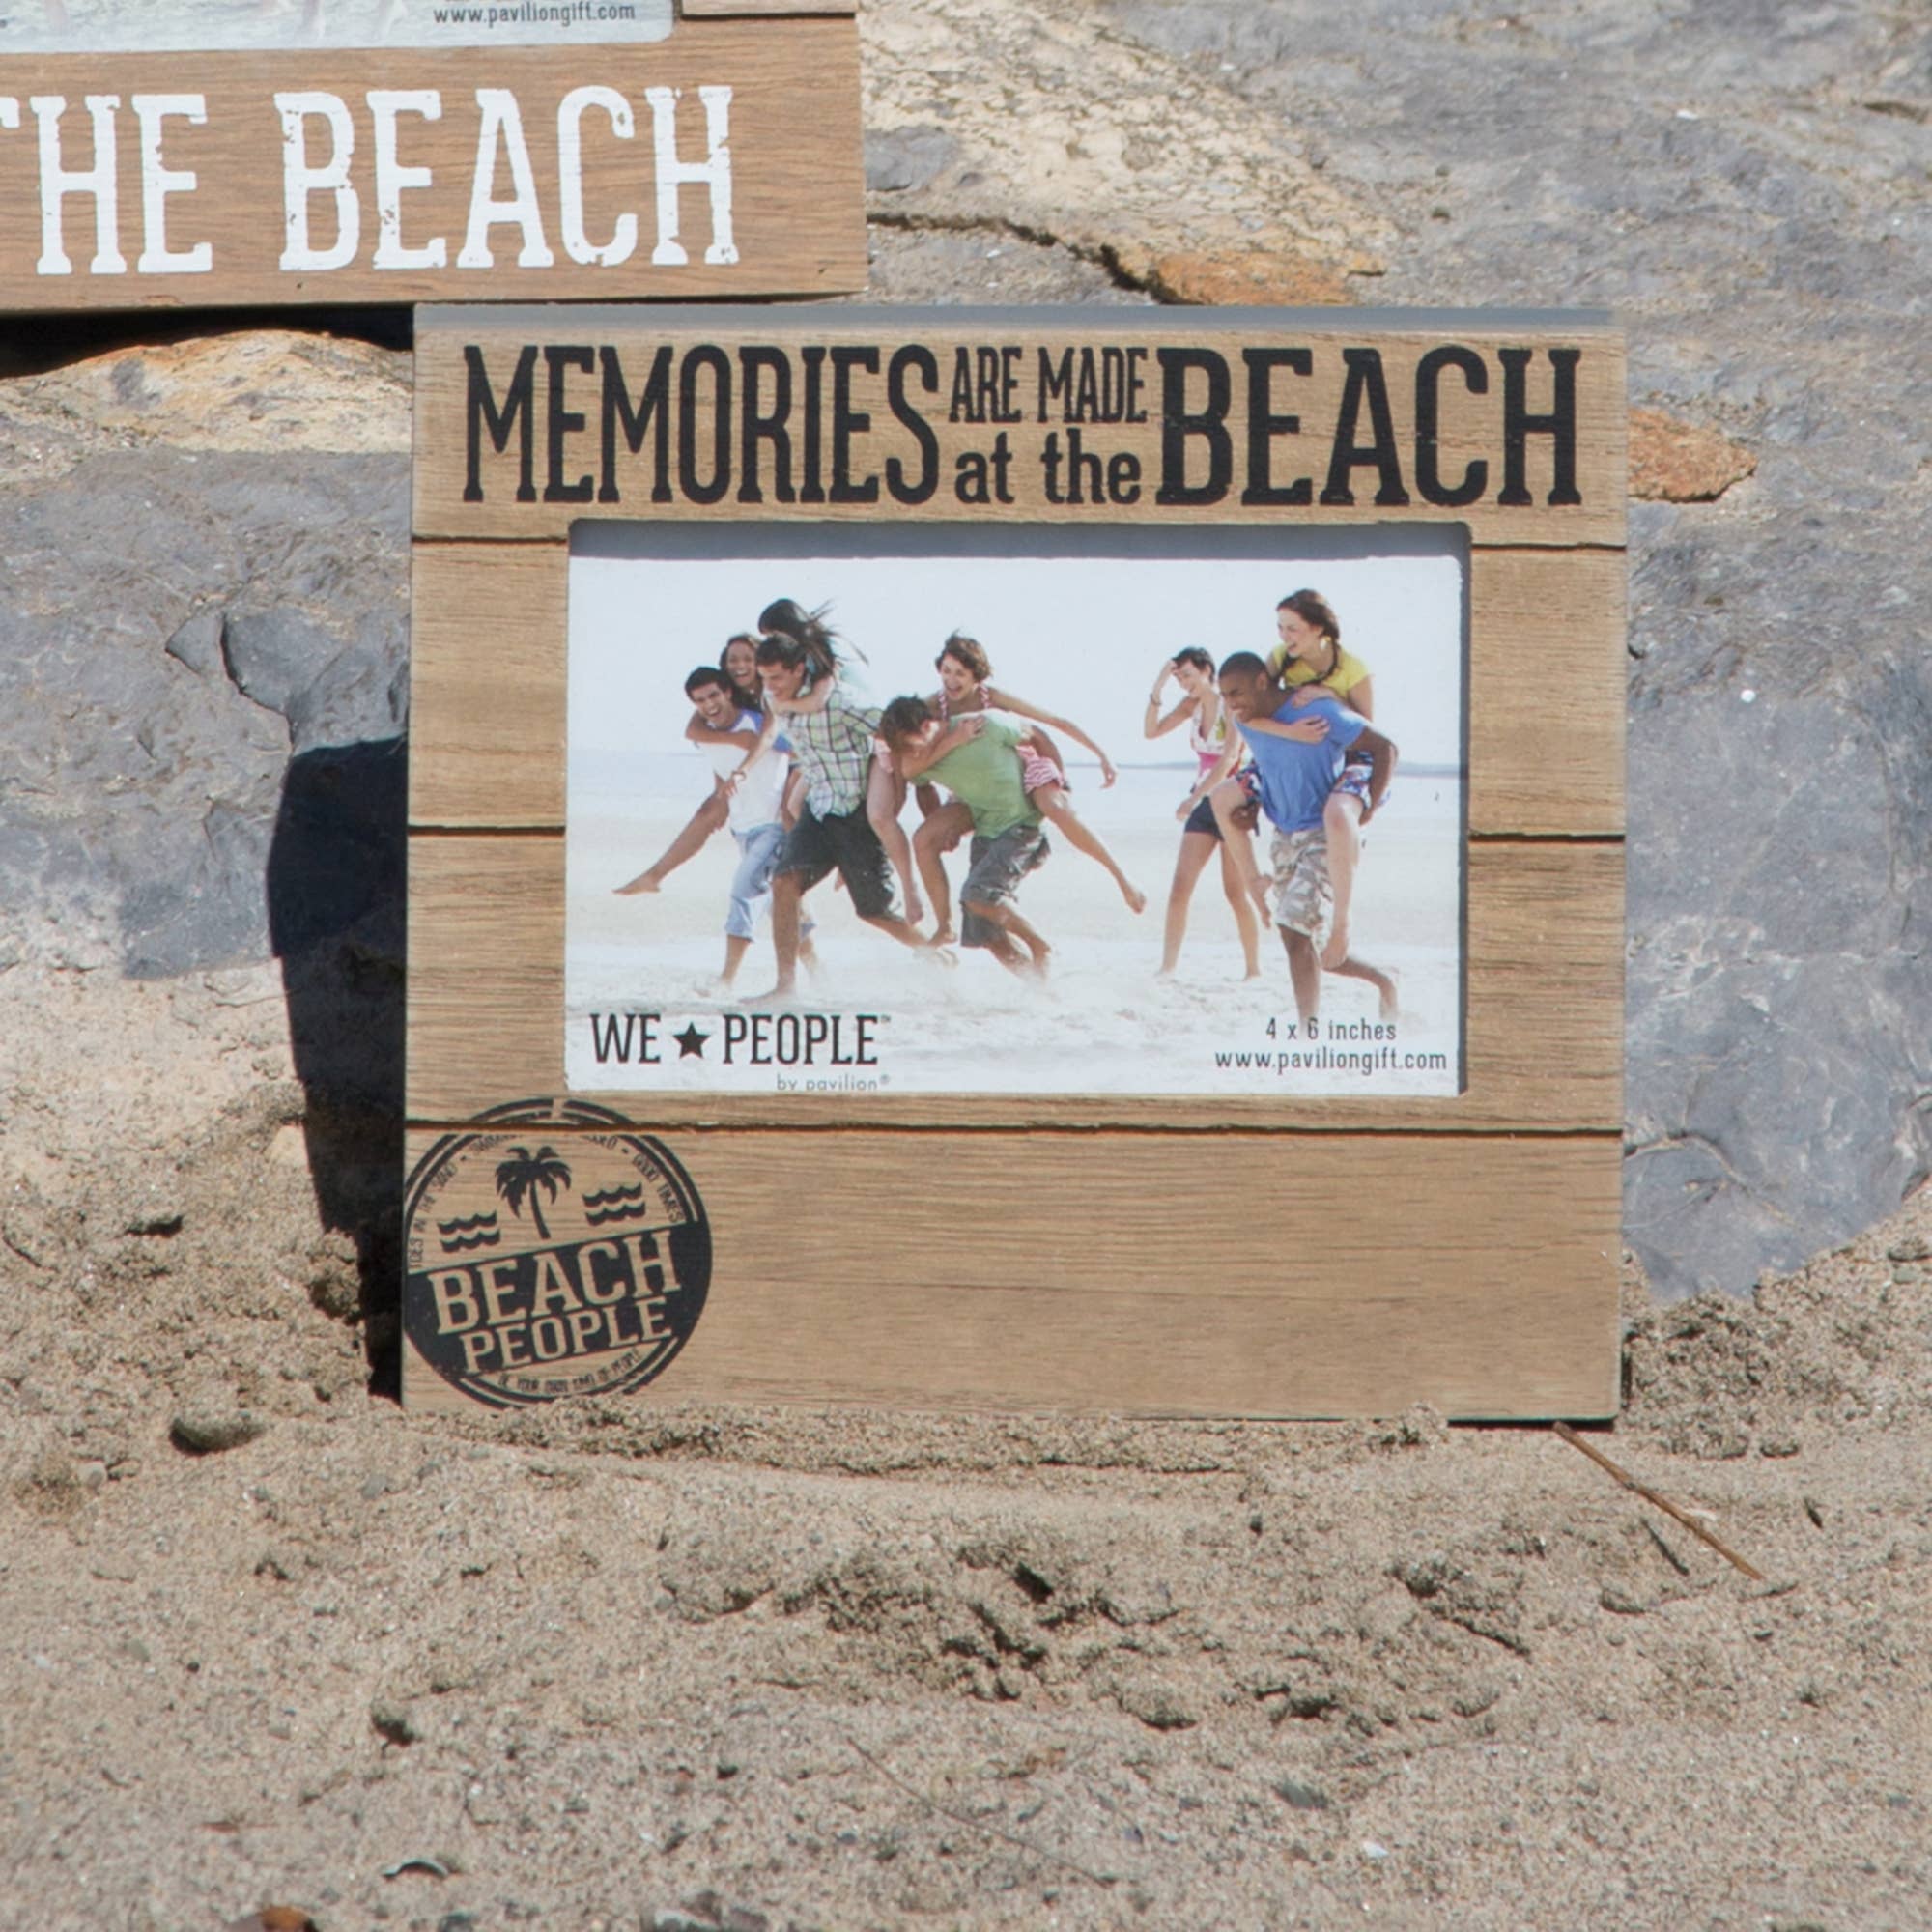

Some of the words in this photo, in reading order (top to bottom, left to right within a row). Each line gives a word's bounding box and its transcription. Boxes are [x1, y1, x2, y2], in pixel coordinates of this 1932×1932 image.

[434, 1, 636, 28] www.paviliongift.com
[0, 94, 213, 274] HE
[274, 85, 739, 270] BEACH
[949, 346, 1022, 423] ARE
[1037, 346, 1148, 424] MADE
[464, 344, 940, 505] MEMORIES
[1156, 344, 1581, 506] BEACH
[954, 432, 1015, 504] at
[1040, 427, 1142, 505] the
[590, 1013, 661, 1064] WE
[1214, 1046, 1447, 1076] www.paviliongift.com
[1265, 1017, 1276, 1039] 4
[1287, 1024, 1297, 1039] x
[1308, 1017, 1319, 1039] 6
[1328, 1018, 1397, 1040] inches
[427, 1229, 681, 1335] BEACH
[458, 1296, 672, 1376] PEOPLE
